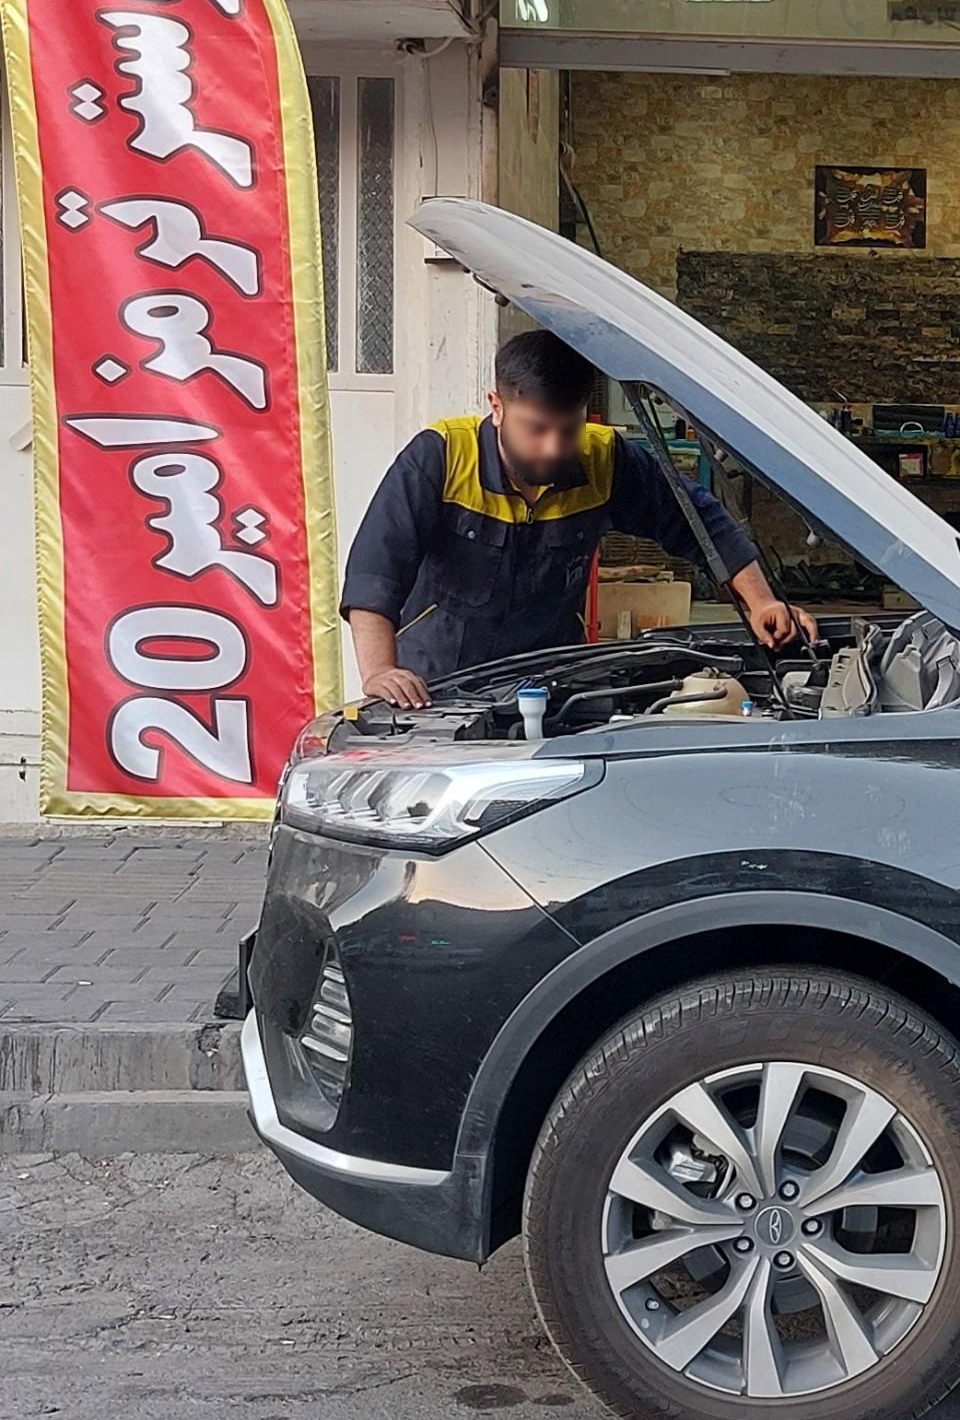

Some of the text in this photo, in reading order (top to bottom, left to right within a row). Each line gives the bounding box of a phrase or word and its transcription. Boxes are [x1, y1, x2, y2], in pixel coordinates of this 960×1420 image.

[55, 186, 268, 411] ترمز
[62, 413, 279, 607] امیر
[105, 602, 256, 784] 20
